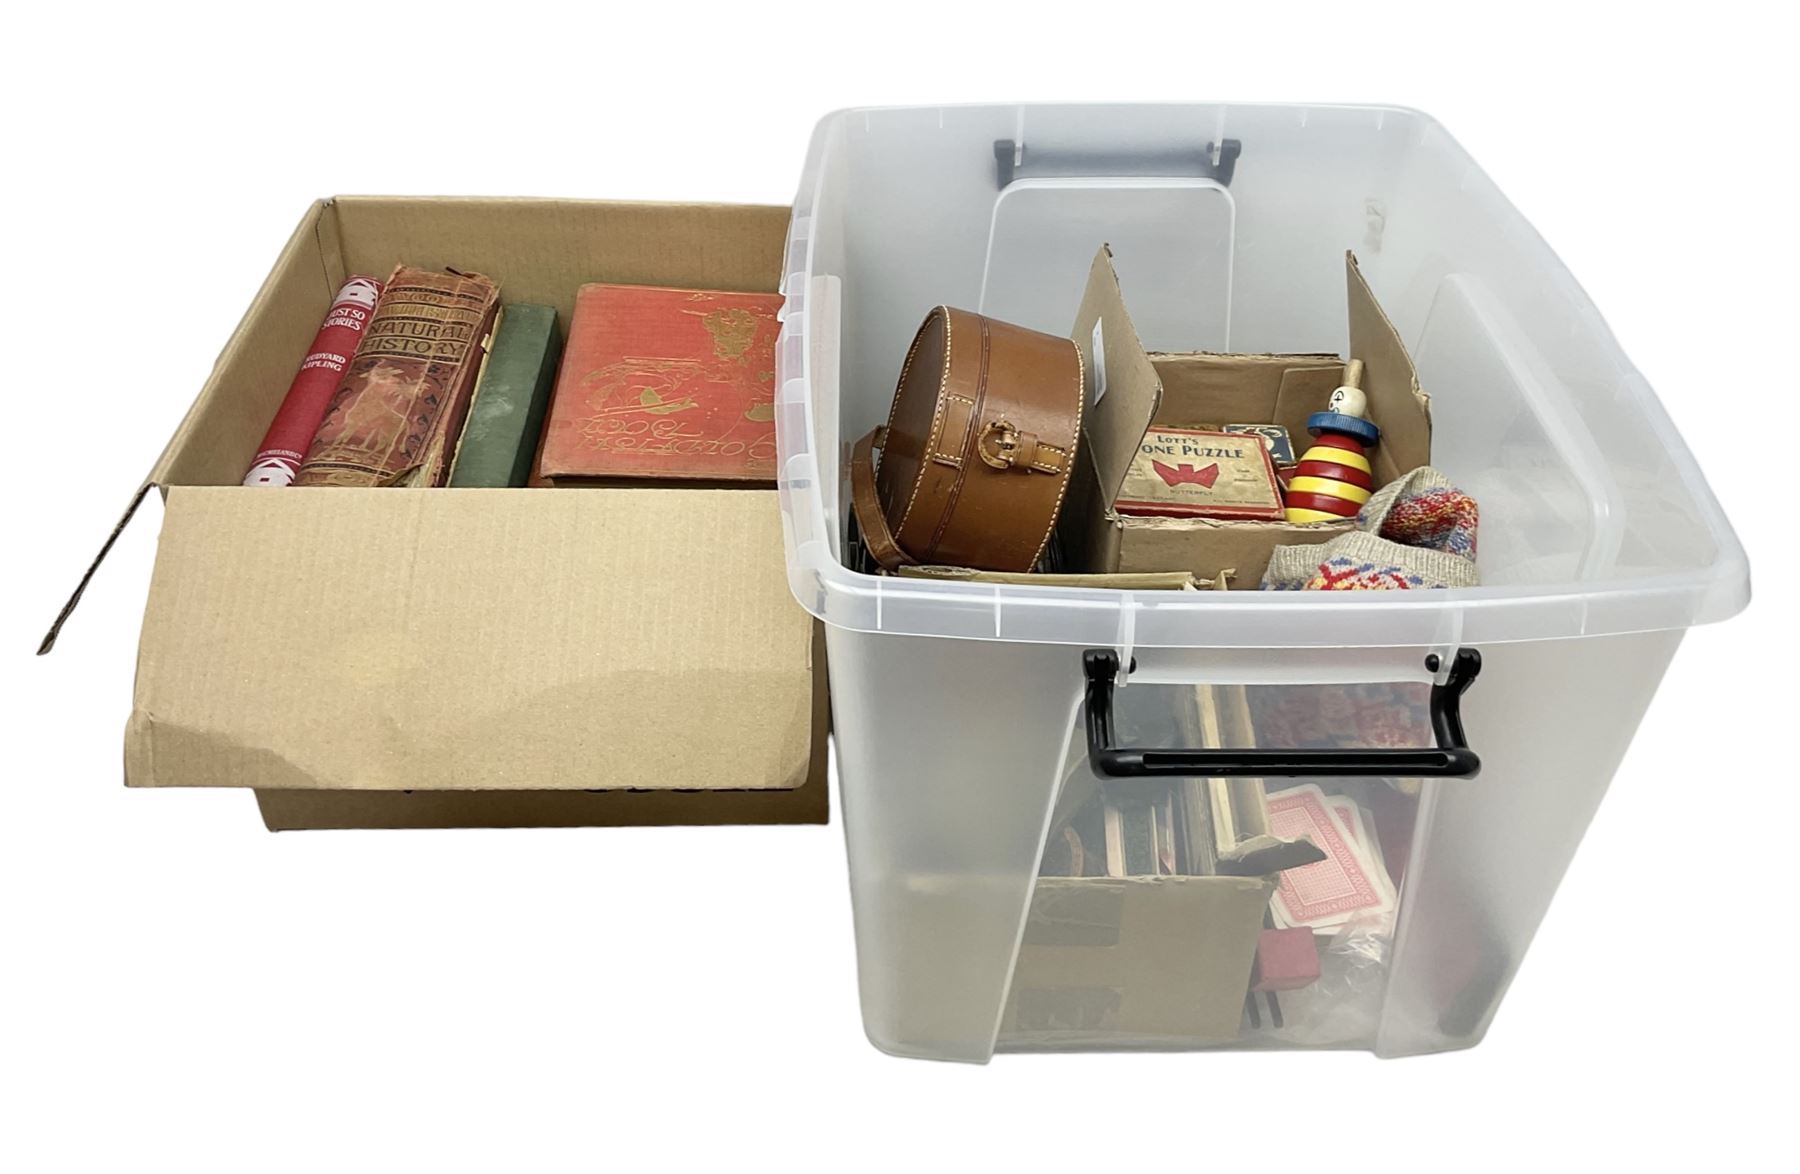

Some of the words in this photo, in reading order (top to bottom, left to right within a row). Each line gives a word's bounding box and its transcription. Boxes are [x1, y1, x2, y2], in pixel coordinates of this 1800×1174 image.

[351, 309, 366, 321] SO
[321, 316, 361, 331] STORIES
[370, 321, 469, 340] NATURAL
[363, 338, 462, 355] HISTORY
[301, 360, 343, 372] KIPLING
[1142, 445, 1175, 456] ONE
[1183, 445, 1245, 459] PUZZLE
